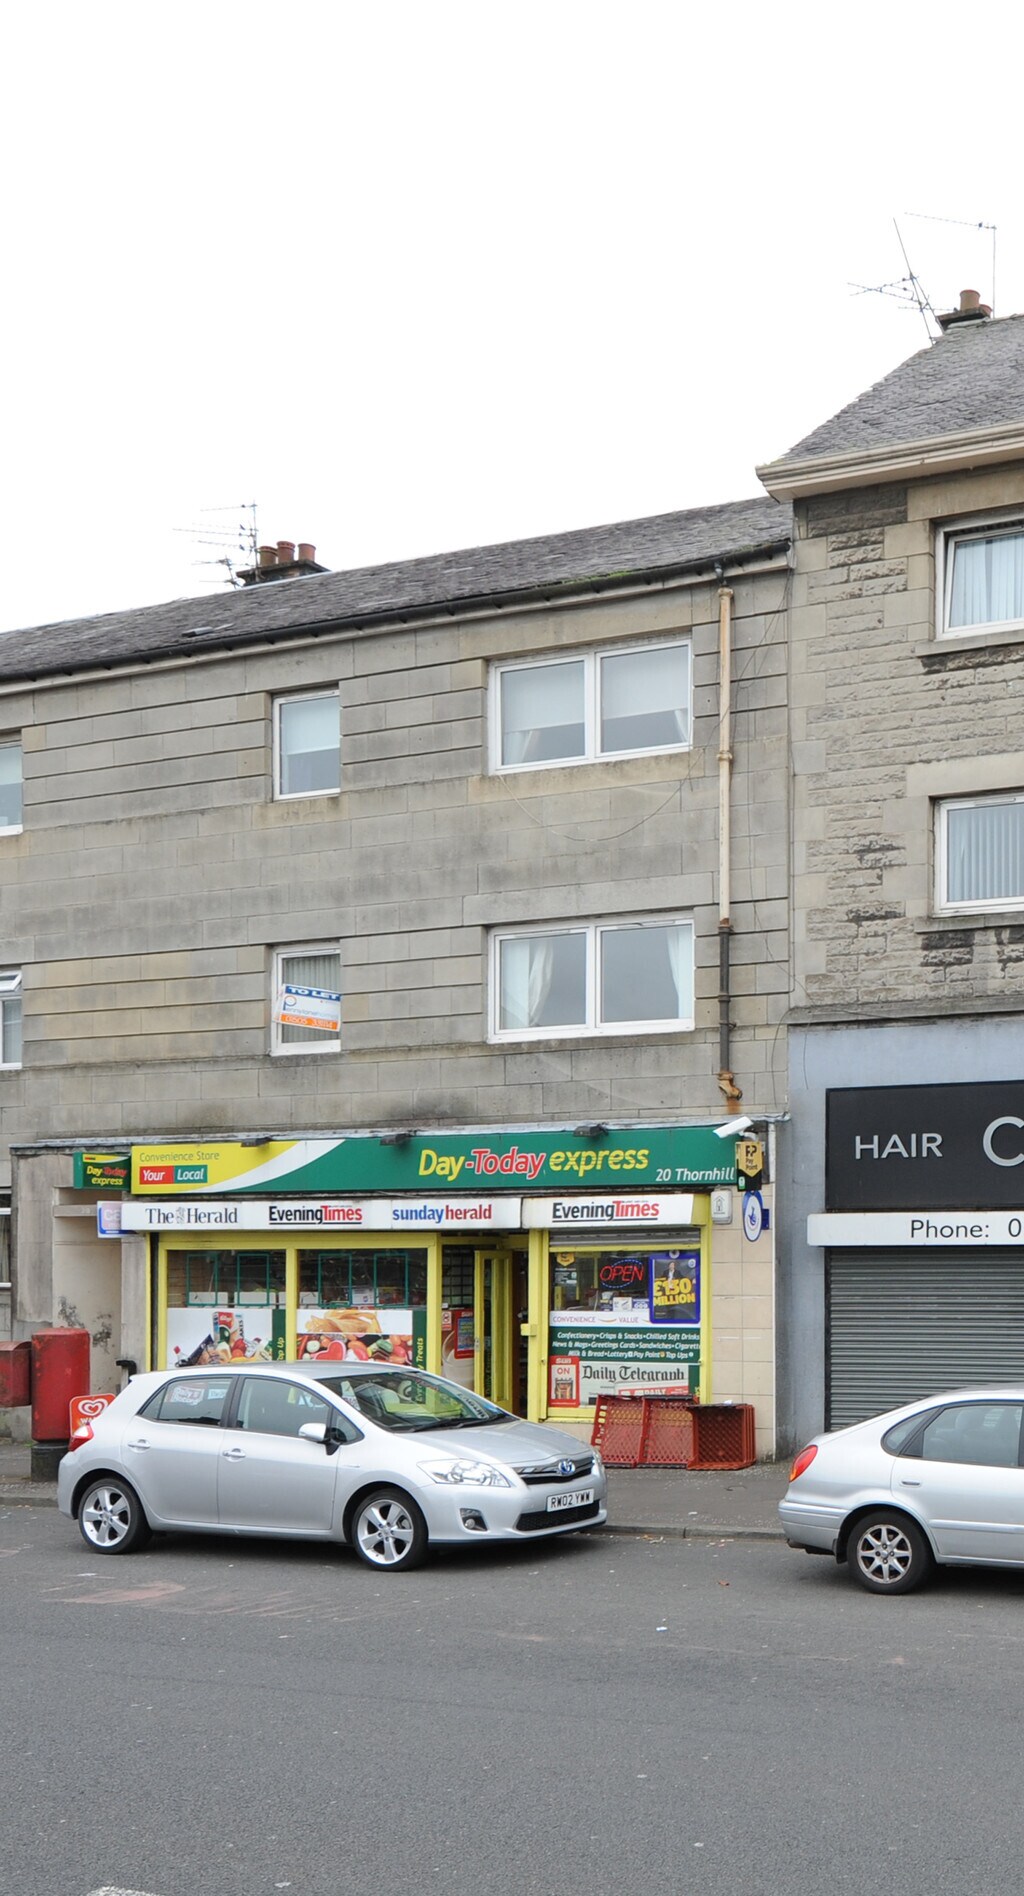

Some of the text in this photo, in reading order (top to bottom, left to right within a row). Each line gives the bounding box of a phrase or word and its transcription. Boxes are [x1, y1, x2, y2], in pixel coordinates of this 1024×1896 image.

[288, 987, 340, 1000] TO LET
[855, 1133, 943, 1160] HAIR
[139, 1151, 220, 1162] Convenience Store
[549, 1149, 649, 1177] express
[91, 1177, 124, 1185] express
[143, 1169, 204, 1181] Your Local
[656, 1167, 735, 1181] 20 Thornhill
[145, 1207, 238, 1224] The Herald
[911, 1219, 990, 1239] Phone:
[600, 1265, 644, 1281] OPEN
[653, 1292, 696, 1307] MILLION
[416, 1338, 425, 1362] Treats
[557, 1367, 570, 1375] ON
[582, 1365, 685, 1382] Daily Telegraph
